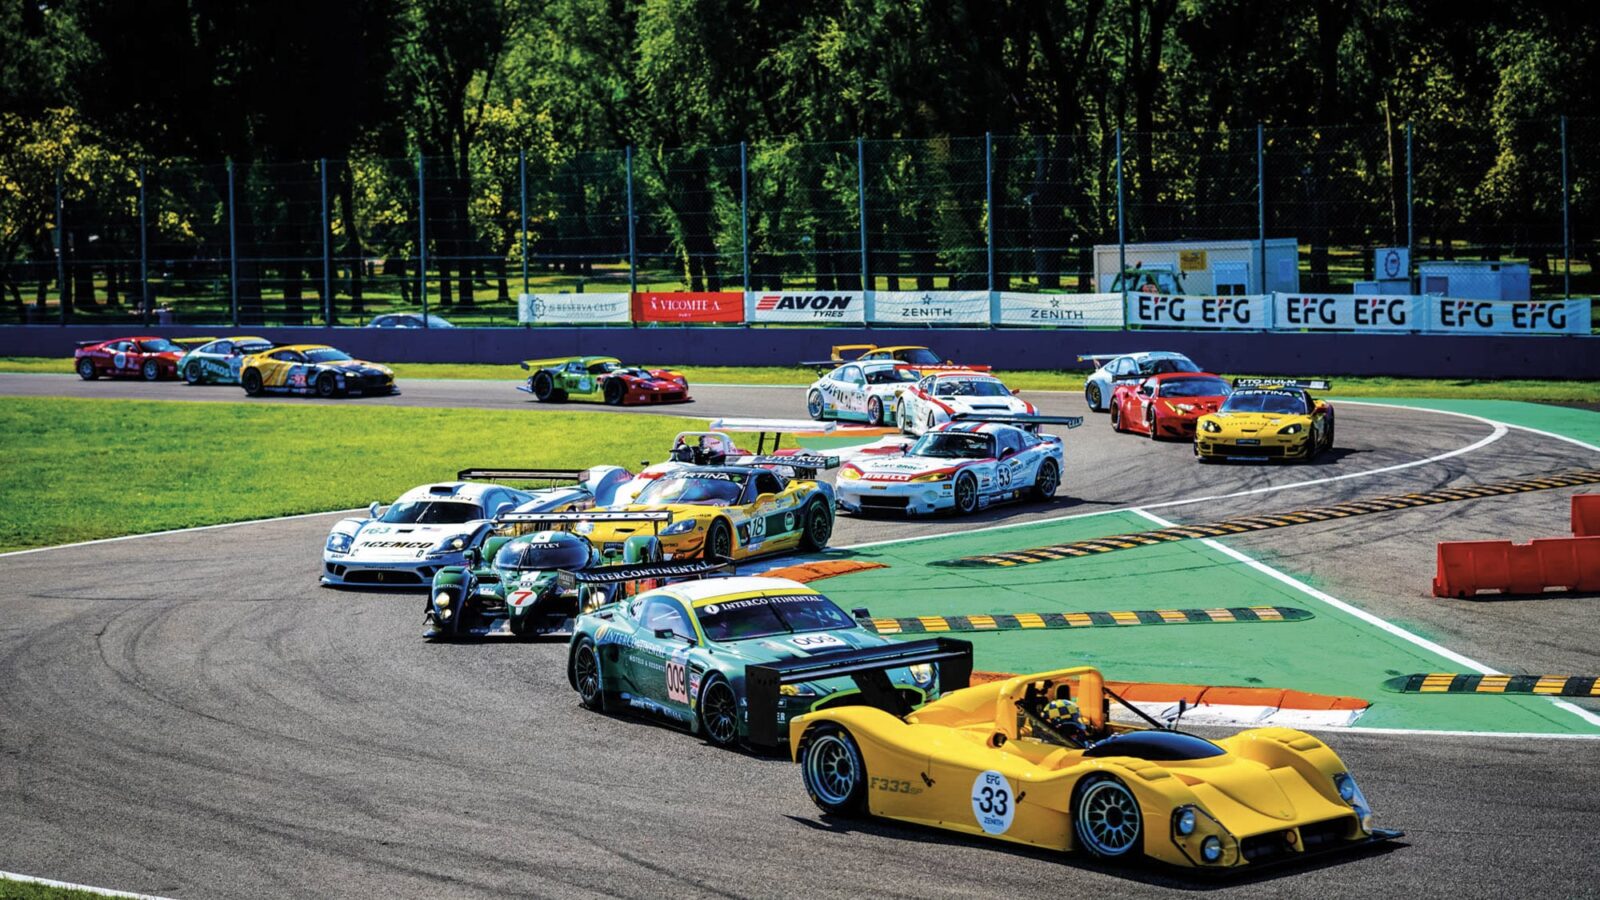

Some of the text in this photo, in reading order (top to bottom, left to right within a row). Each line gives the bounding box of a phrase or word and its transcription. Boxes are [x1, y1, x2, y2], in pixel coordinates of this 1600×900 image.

[660, 299, 708, 311] VICOMTE
[776, 296, 853, 310] AVON
[1138, 296, 1185, 321] EFG
[813, 310, 845, 318] TYRES
[902, 308, 952, 317] ZENITH
[1030, 309, 1084, 319] ZENITH
[1202, 298, 1250, 323] EFG
[1287, 298, 1336, 324] EFG
[1354, 298, 1406, 325] EFG
[1440, 300, 1493, 327] EFG
[1512, 303, 1566, 329] EFG
[672, 471, 730, 481] ERTINA
[861, 472, 911, 481] PIRELLI
[998, 467, 1010, 487] 53
[752, 516, 764, 536] 18
[360, 541, 435, 549] ACEMCO
[585, 560, 714, 583] INTERCONTINENTAL
[514, 591, 533, 605] 7
[792, 635, 836, 646] 009
[667, 663, 686, 696] 009
[986, 774, 1000, 786] EFG
[979, 786, 1008, 816] 33
[984, 816, 1004, 827] ZENITH
